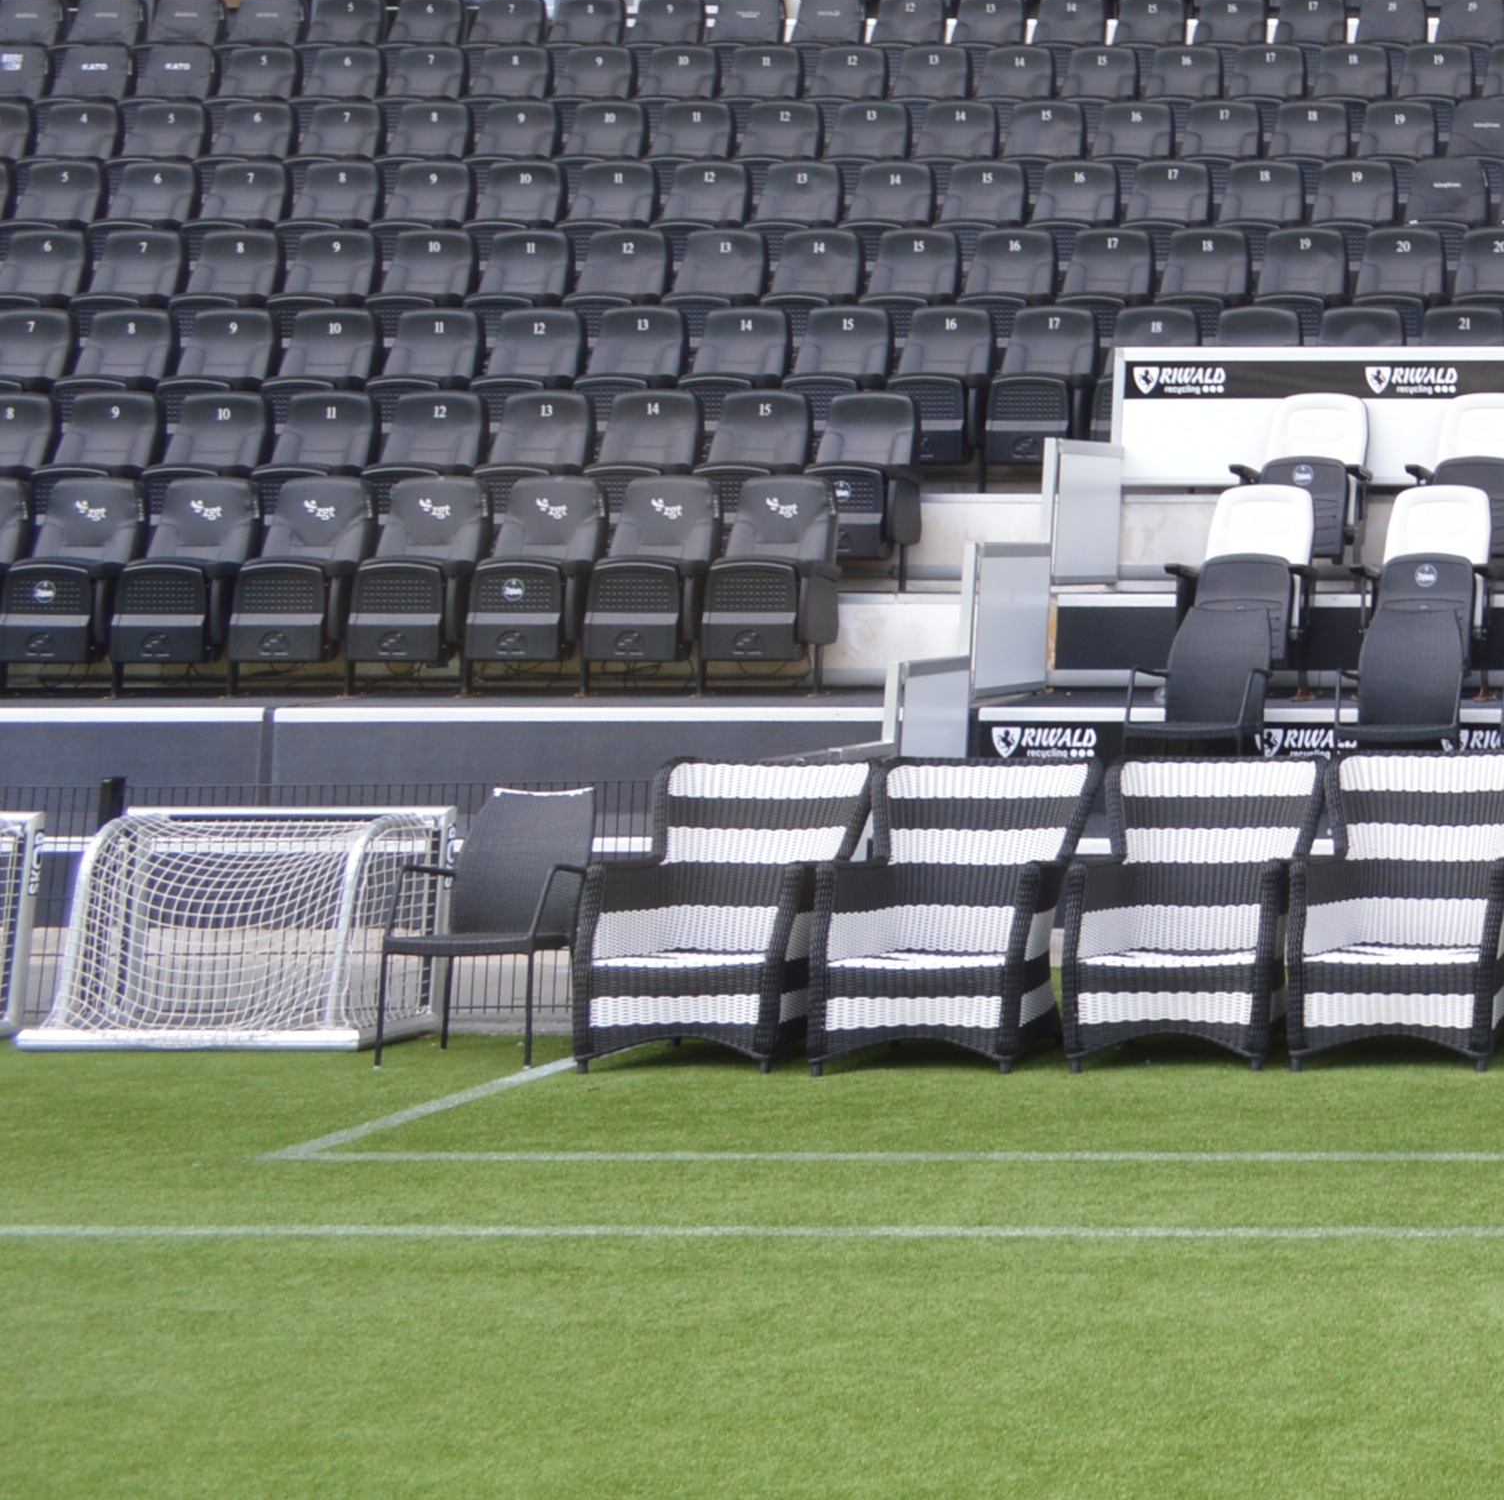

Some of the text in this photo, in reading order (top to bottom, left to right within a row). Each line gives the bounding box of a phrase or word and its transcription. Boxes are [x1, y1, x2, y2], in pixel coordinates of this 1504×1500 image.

[347, 2, 355, 13] 5
[81, 63, 108, 71] KATO
[165, 63, 191, 71] KATO
[847, 55, 858, 66] 12
[80, 113, 88, 124] 4
[866, 110, 878, 121] 13
[338, 172, 347, 184] 8
[1167, 168, 1179, 180] 17
[43, 240, 53, 253] 6
[236, 241, 245, 254] 8
[428, 241, 442, 253] 10
[622, 241, 635, 255] 12
[813, 242, 826, 254] 14
[1009, 239, 1022, 252] 16
[1202, 240, 1214, 252] 18
[1396, 240, 1412, 253] 20
[27, 320, 36, 333] 7
[127, 322, 136, 335] 8
[229, 321, 238, 334] 9
[328, 322, 342, 335] 10
[434, 321, 445, 334] 11
[533, 322, 546, 335] 12
[637, 318, 650, 331] 13
[740, 319, 753, 332] 14
[842, 318, 855, 331] 15
[945, 318, 958, 331] 16
[1048, 316, 1061, 330] 17
[1150, 321, 1163, 334] 18
[1458, 316, 1471, 331] 21
[1159, 366, 1225, 385] RIWALD
[1392, 366, 1458, 385] RIWALD
[1164, 384, 1201, 395] recycling
[1397, 384, 1434, 395] recycling
[5, 407, 15, 420] 8
[110, 405, 121, 419] 9
[217, 407, 232, 421] 10
[326, 406, 337, 420] 11
[433, 405, 447, 419] 12
[540, 404, 553, 417] 13
[647, 402, 660, 415] 14
[759, 403, 772, 417] 15
[1021, 727, 1097, 747] RIWALD
